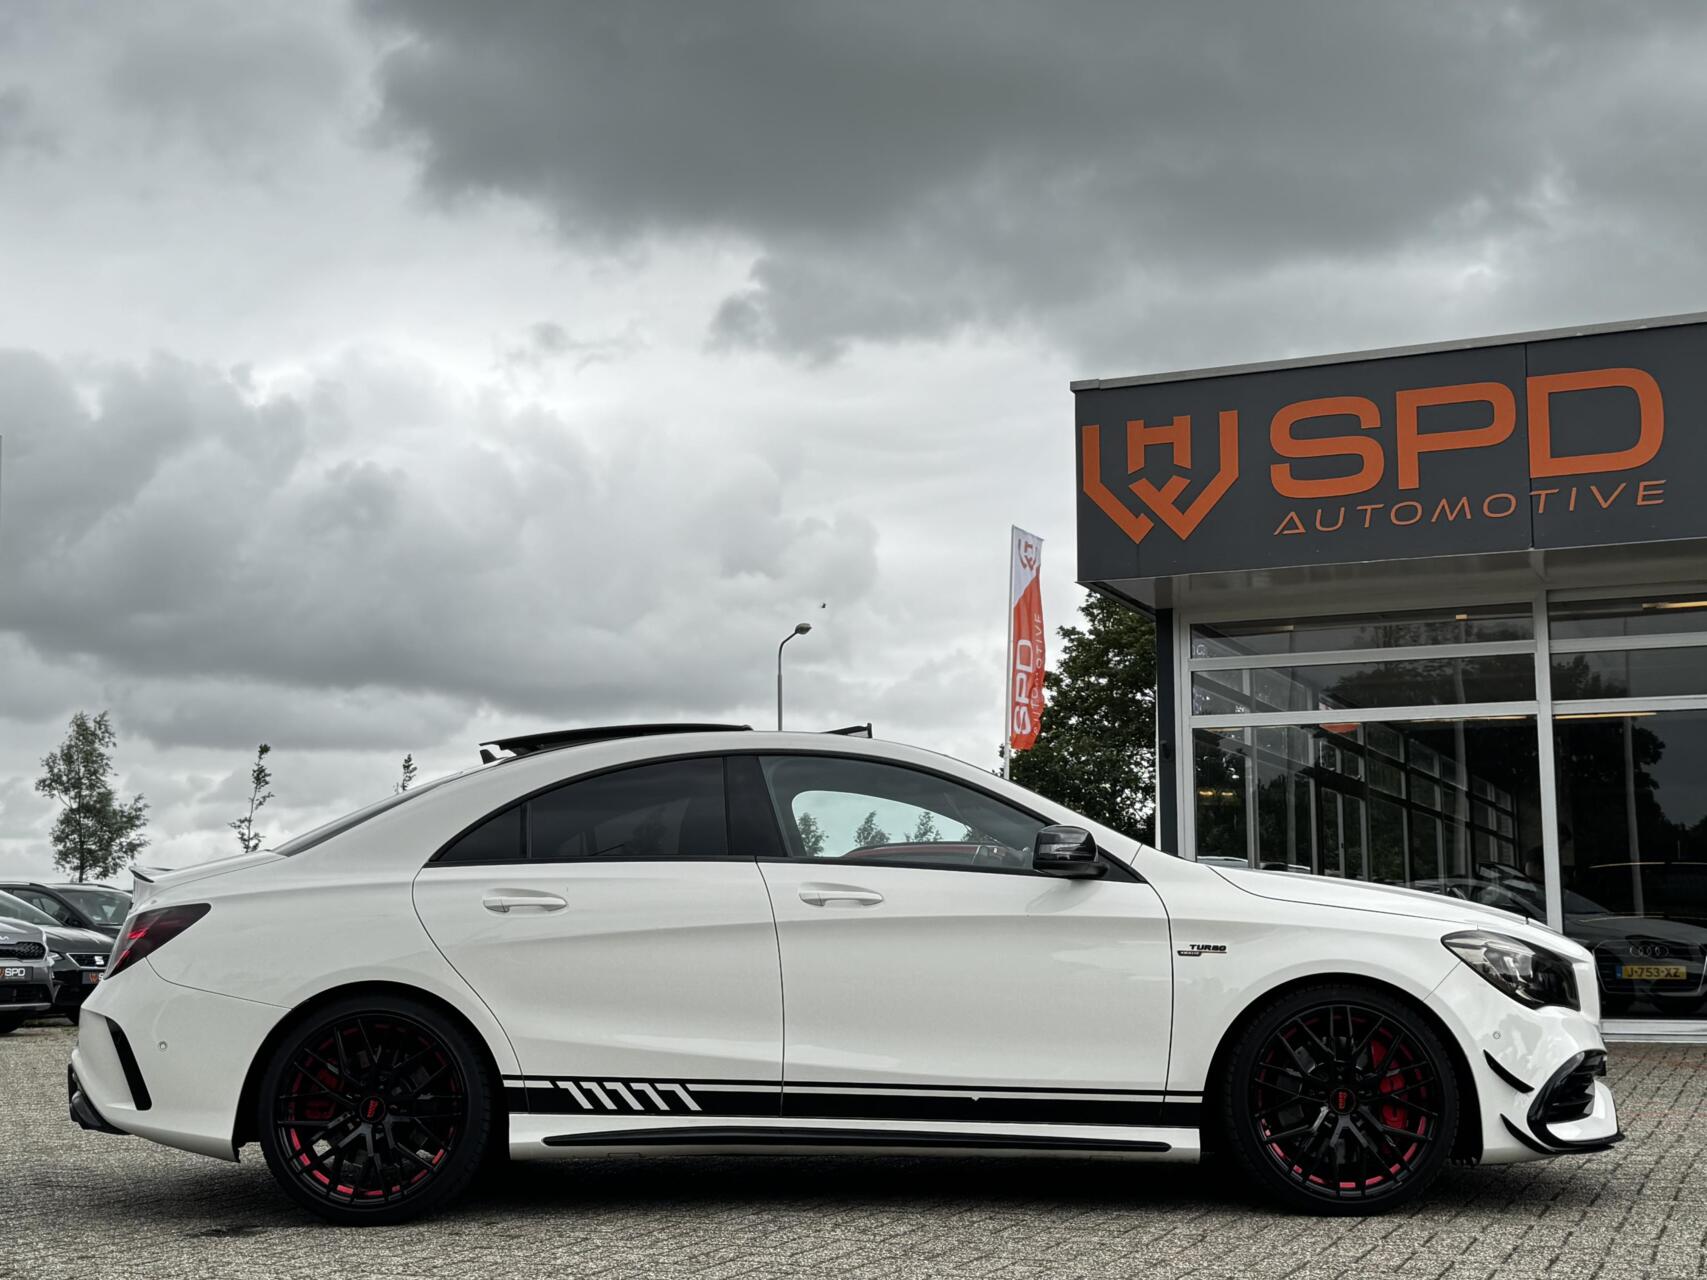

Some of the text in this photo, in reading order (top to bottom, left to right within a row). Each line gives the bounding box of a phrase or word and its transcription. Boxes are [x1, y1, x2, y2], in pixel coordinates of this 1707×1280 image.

[1269, 367, 1665, 499] SPD
[1273, 479, 1667, 536] AUTOMOTIVE
[1013, 639, 1033, 735] SPD
[1189, 944, 1227, 952] TURBO
[5, 967, 26, 977] SPD
[1627, 967, 1681, 978] J-753-XZ
